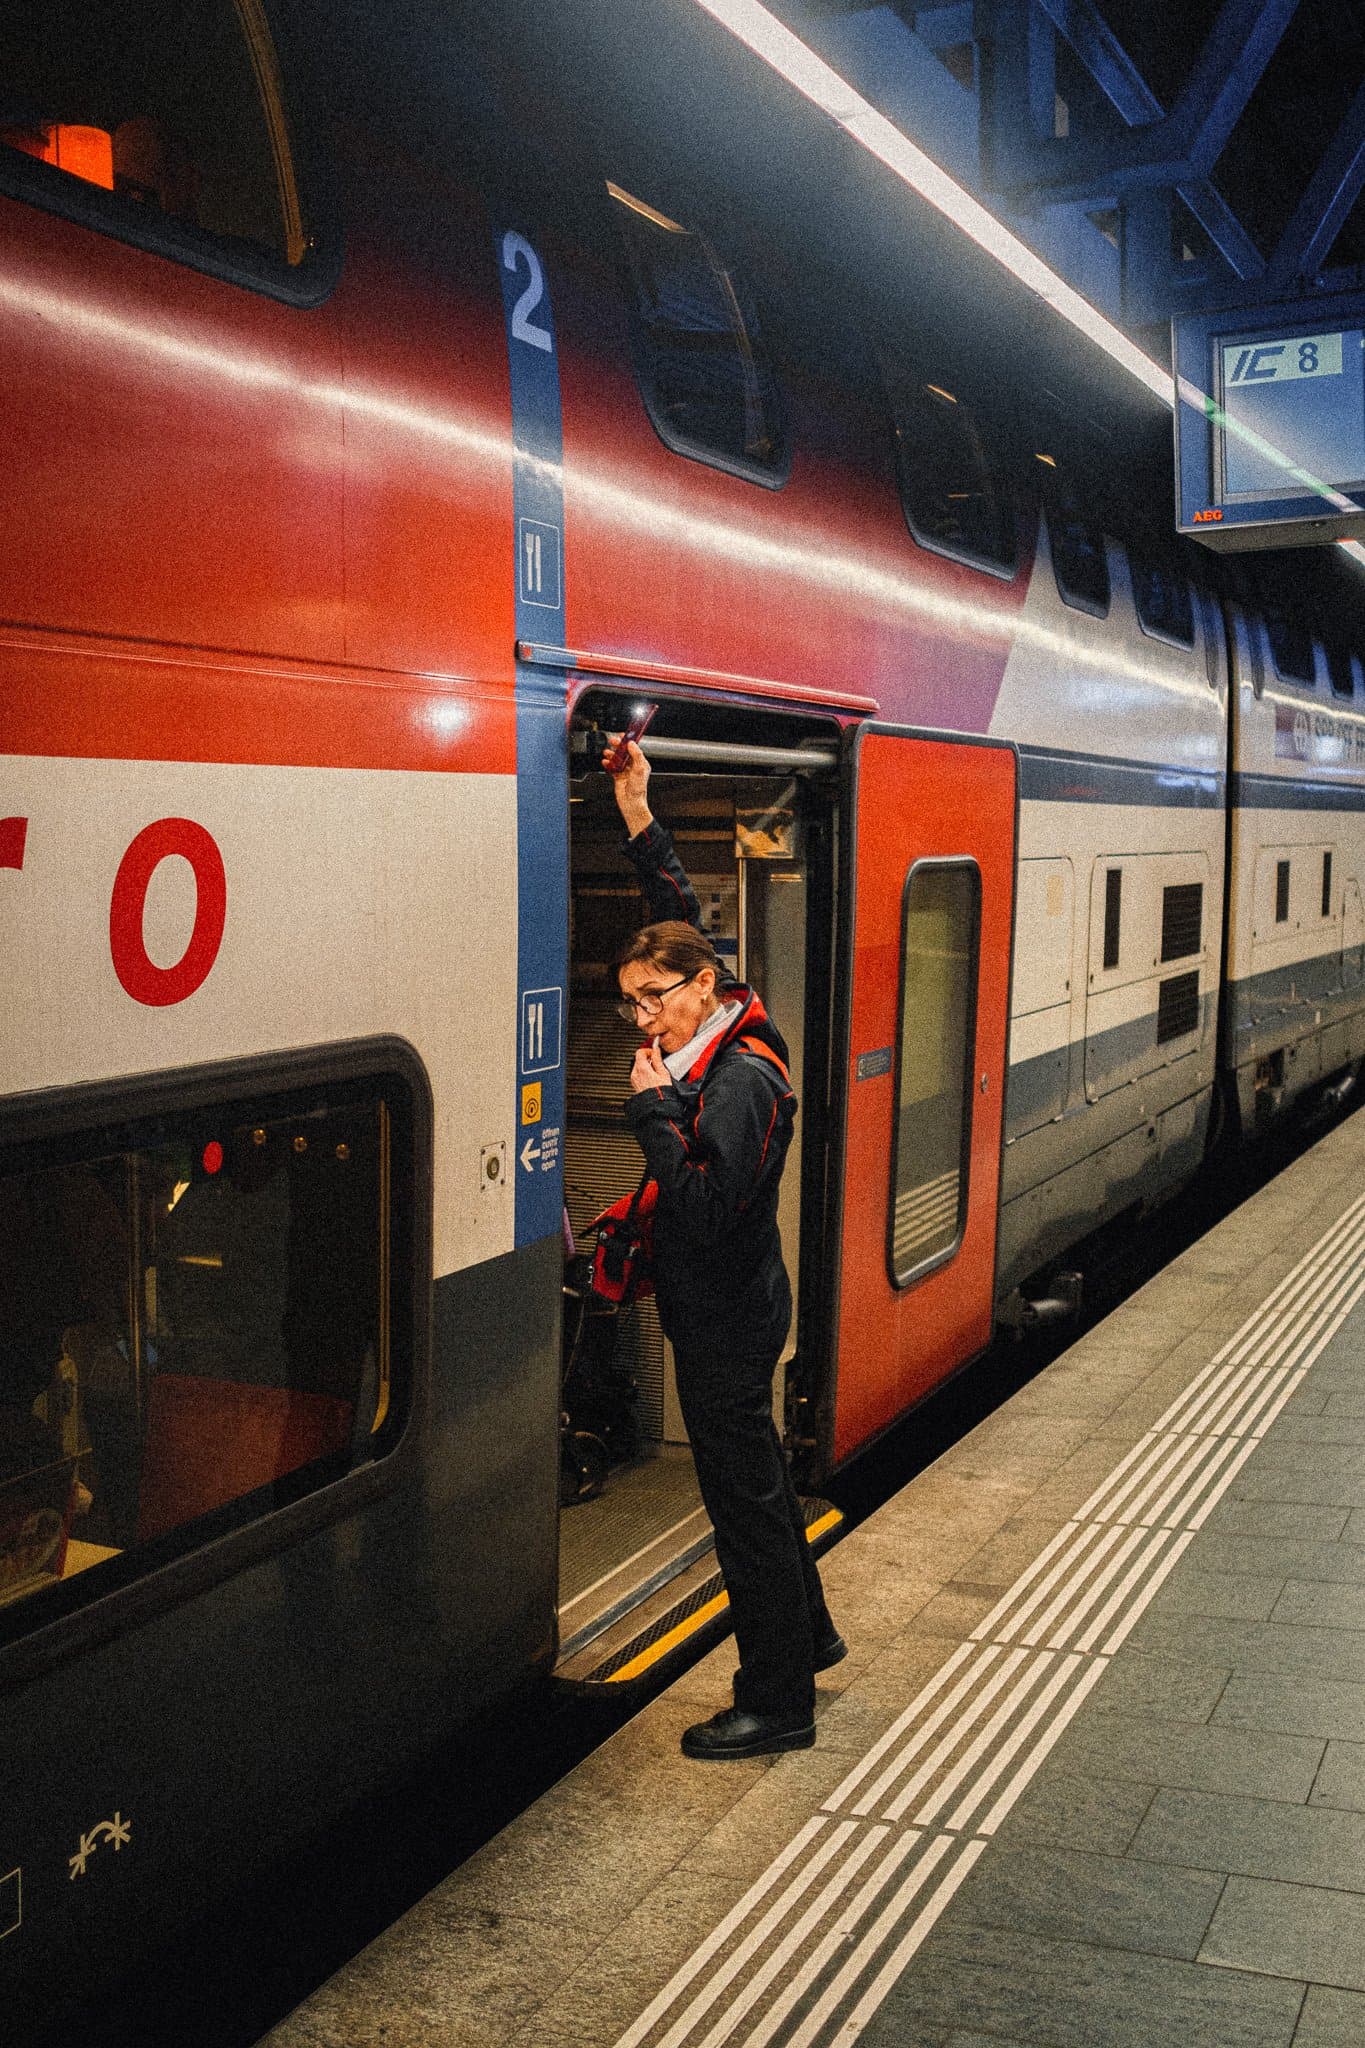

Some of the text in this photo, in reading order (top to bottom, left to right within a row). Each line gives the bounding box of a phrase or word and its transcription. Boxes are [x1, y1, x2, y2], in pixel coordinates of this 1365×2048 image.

[503, 230, 553, 353] 2
[1230, 341, 1319, 382] IC 8
[1193, 509, 1224, 523] AEG
